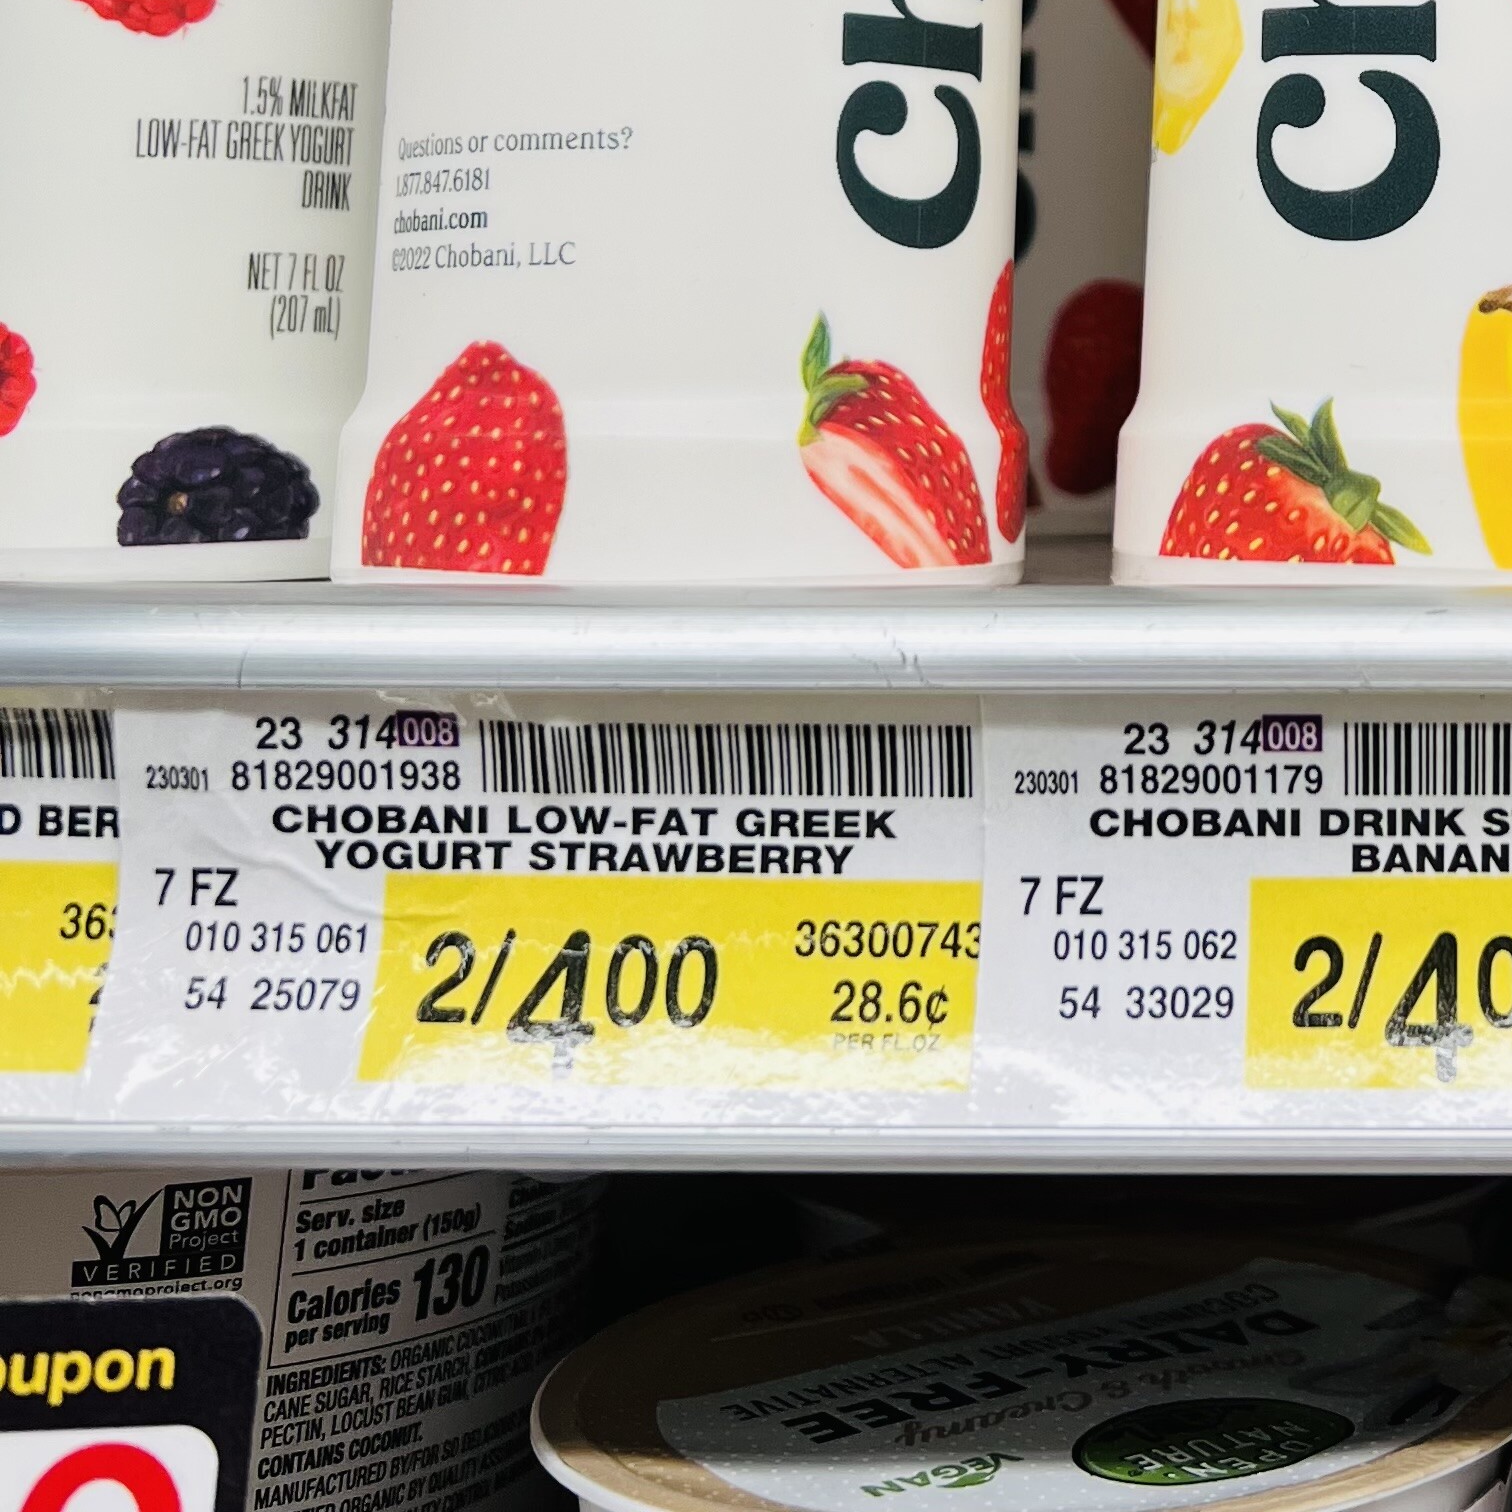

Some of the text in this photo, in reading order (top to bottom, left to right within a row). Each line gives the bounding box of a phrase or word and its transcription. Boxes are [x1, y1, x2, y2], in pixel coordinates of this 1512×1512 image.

[243, 75, 359, 122] 1.5% MILKFAT
[136, 118, 355, 167] LOW-FAT GREEK YOGURT
[398, 126, 634, 162] Questions comments?
[301, 169, 352, 212] DRINK
[394, 206, 489, 235] chobani.com
[247, 251, 283, 292] NET
[434, 240, 577, 270] Chobani, LLC
[256, 716, 303, 751] 23
[1124, 722, 1170, 755] 23
[145, 759, 461, 792] 230301 81829001938
[1015, 764, 1324, 795] 230301 81829001179
[272, 803, 898, 840] CHOBANI LOW-FAT GREEK
[1089, 808, 1301, 837] CHOBANI
[1320, 808, 1466, 837] DRINK
[315, 839, 855, 876] YOGURT STRAWBERRY
[155, 868, 239, 907] 7 FZ
[1020, 876, 1104, 916] 7 FZ
[185, 920, 369, 954] 010 315 061
[795, 919, 981, 960] 36300743
[1054, 929, 1239, 960] 010 315 062
[184, 977, 362, 1011] 54 25079
[831, 979, 950, 1031] 28.6¢
[1059, 985, 1236, 1019] 54 33029
[833, 1033, 875, 1052] PER
[174, 1184, 243, 1210] NON
[170, 1206, 243, 1232] GMO
[295, 1197, 406, 1235] Serv. size
[168, 1229, 239, 1251] Project
[313, 1222, 420, 1260] container
[83, 1253, 237, 1283] VERIFIED
[287, 1244, 492, 1325] Calories 130
[284, 1311, 391, 1354] per serving
[0, 1346, 176, 1408] upon
[265, 1354, 387, 1398] INGREDIENTS:
[260, 1399, 398, 1451] PECTIN, LOCUST
[263, 1393, 312, 1424] CANE
[257, 1442, 346, 1480] CONTAINS
[1122, 1419, 1310, 1475] NATURE
[253, 1458, 388, 1512] MANUFACTURED
[860, 1452, 1024, 1498] VEGAN
